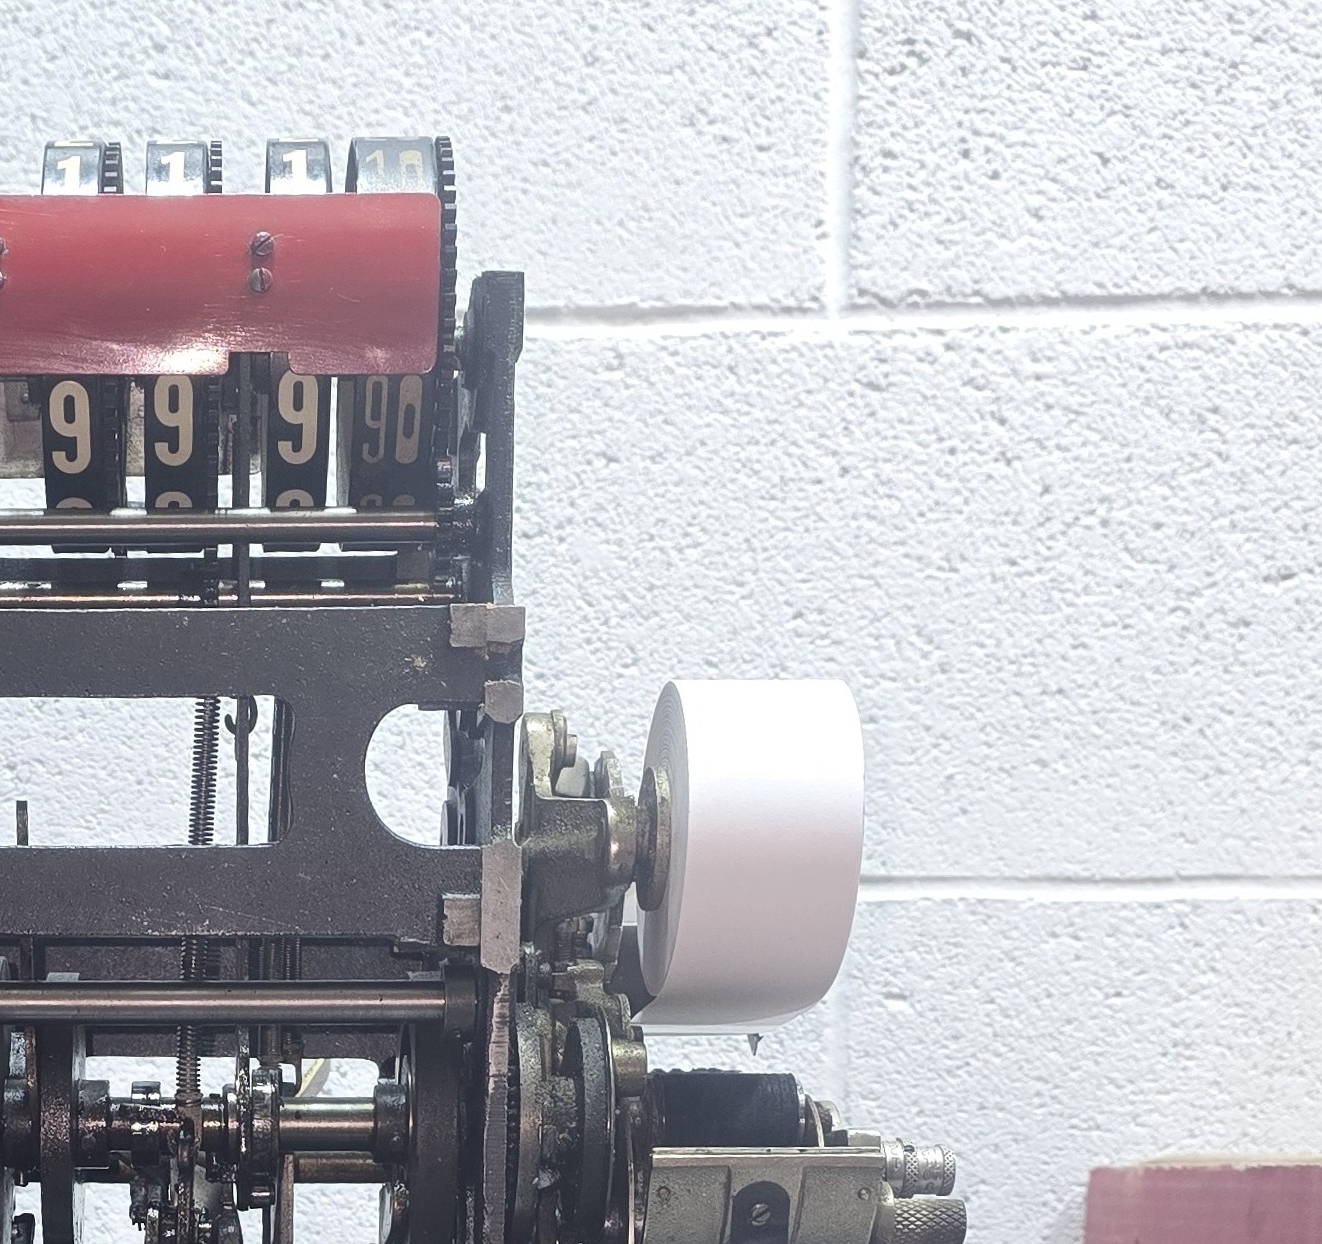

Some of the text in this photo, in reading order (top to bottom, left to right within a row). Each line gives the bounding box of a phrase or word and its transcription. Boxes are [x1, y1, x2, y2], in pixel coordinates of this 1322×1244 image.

[49, 373, 424, 474] 9 9 9 90
